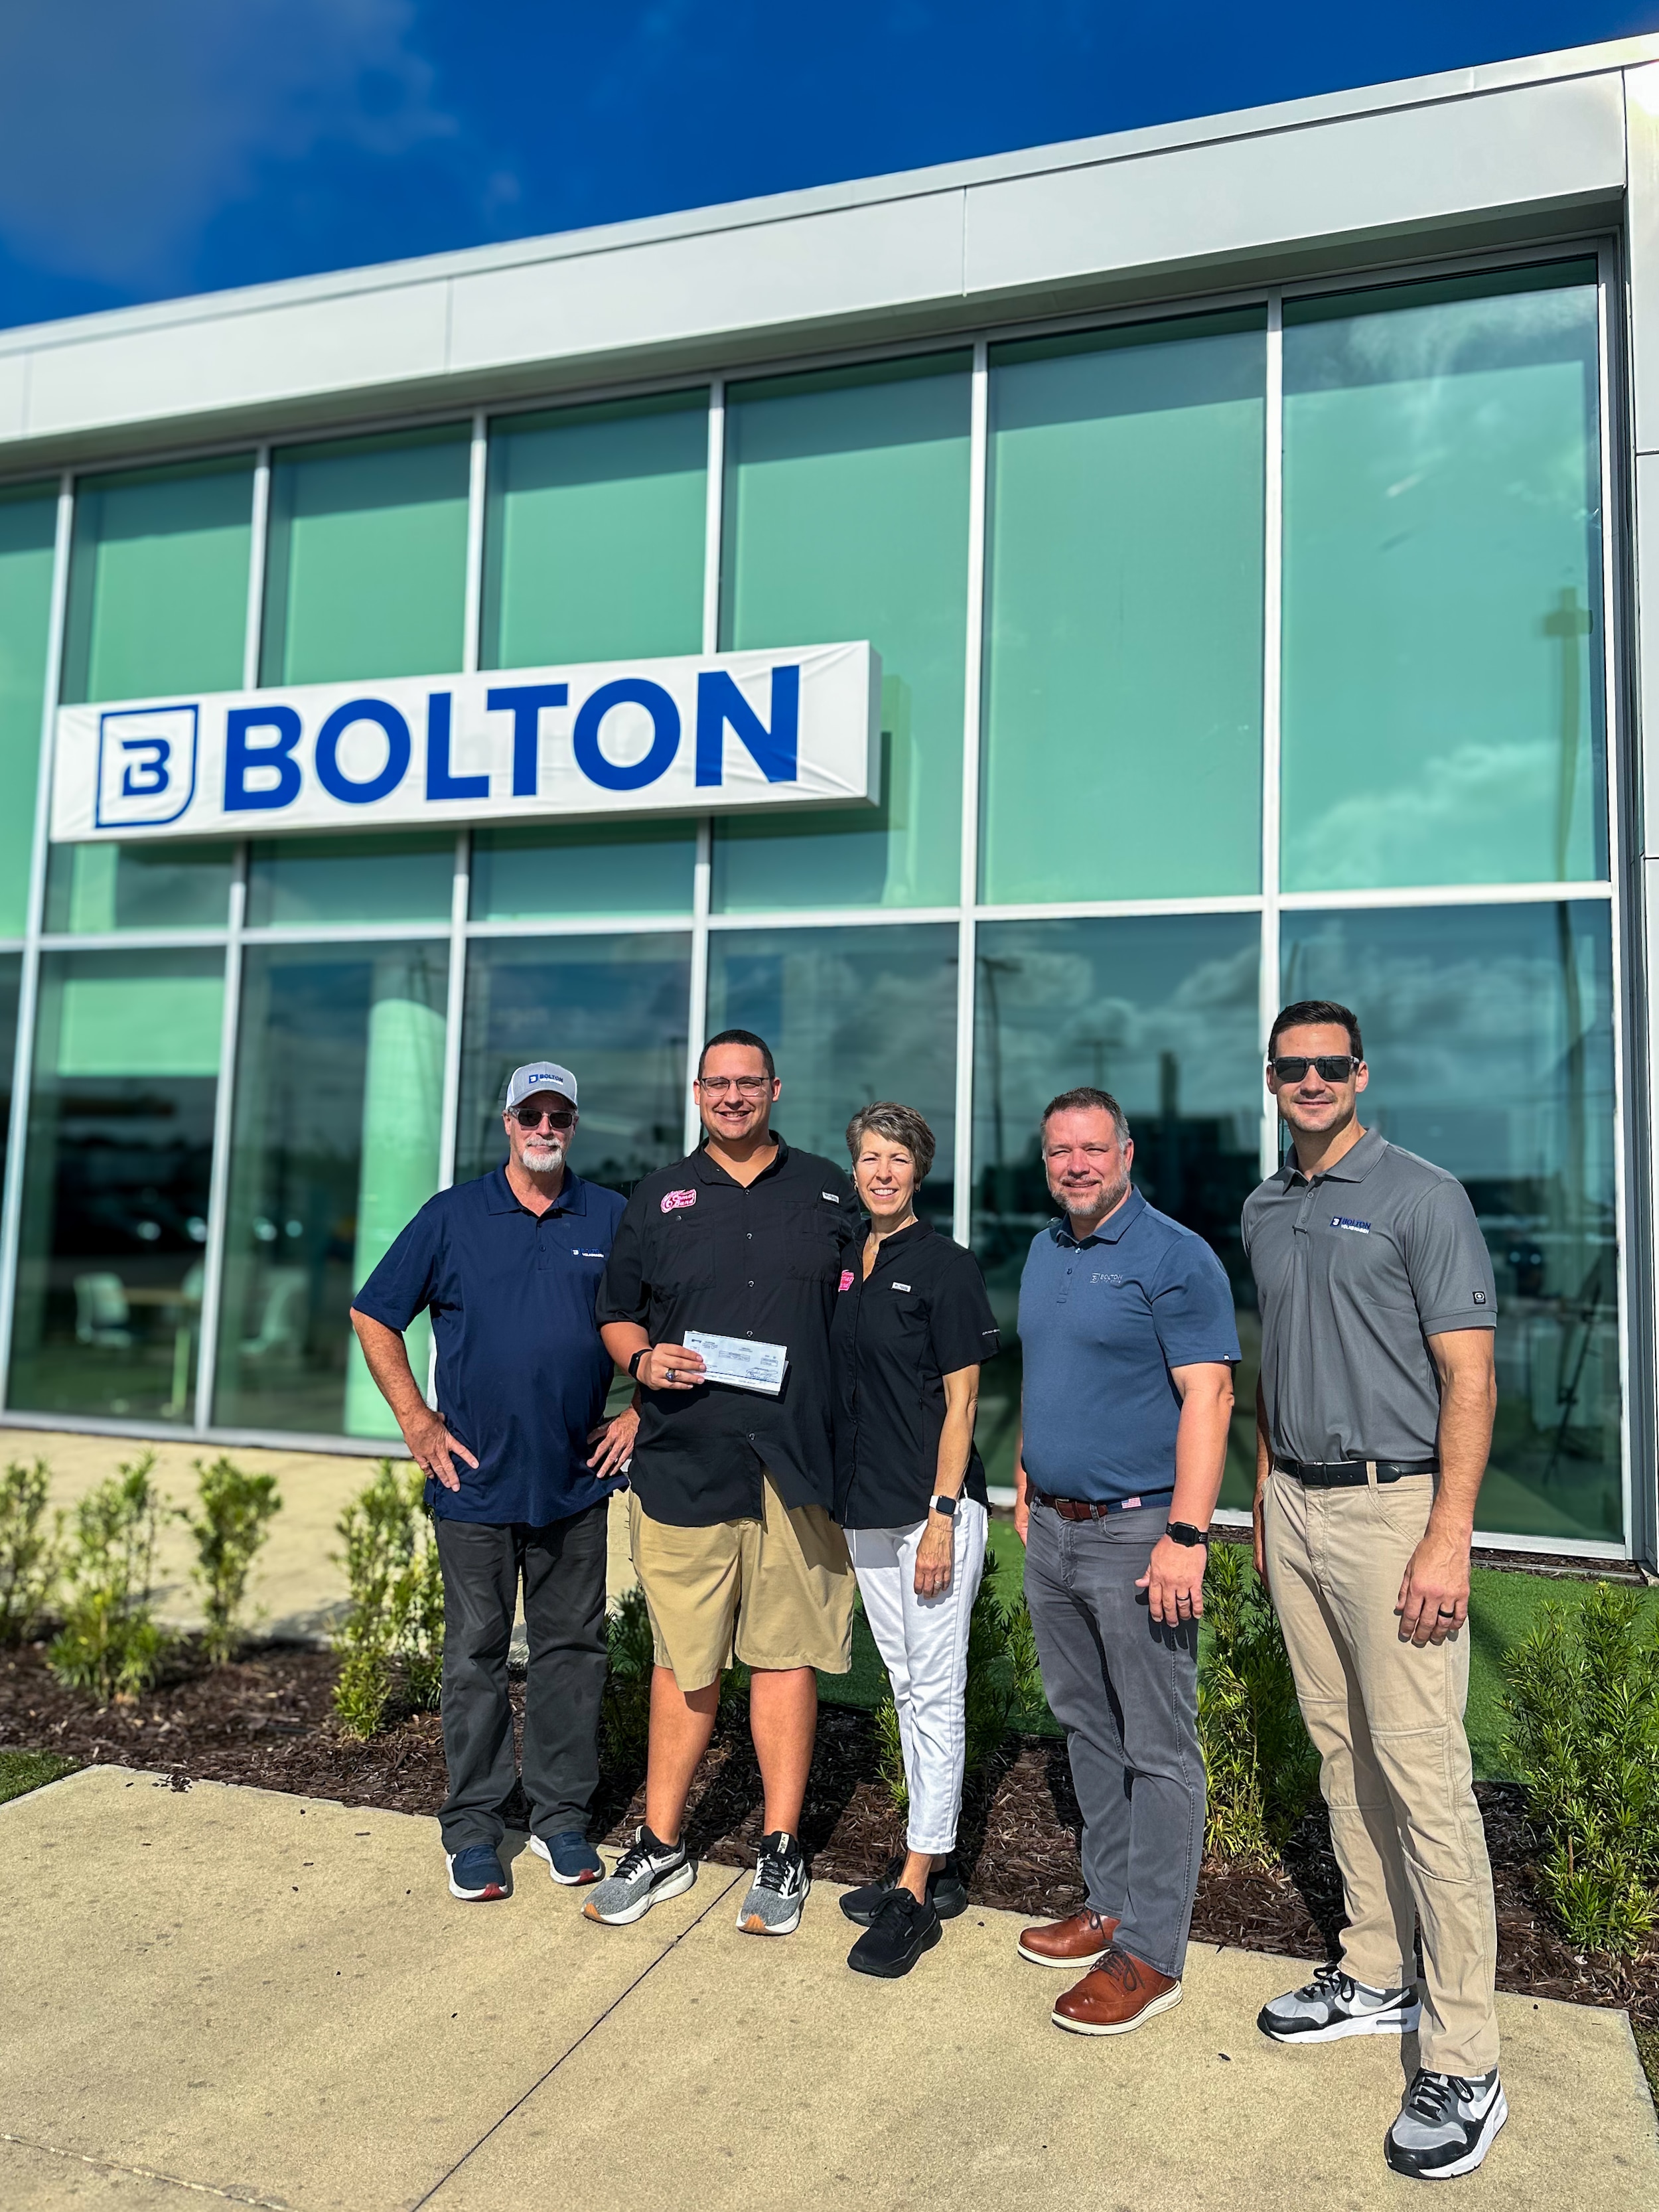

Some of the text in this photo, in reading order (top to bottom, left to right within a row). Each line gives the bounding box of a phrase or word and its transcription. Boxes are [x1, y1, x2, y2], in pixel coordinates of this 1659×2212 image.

[224, 664, 800, 811] BOLTON
[540, 1074, 563, 1082] BOLTON
[673, 1197, 695, 1207] Band
[1342, 1217, 1371, 1230] BOLTON
